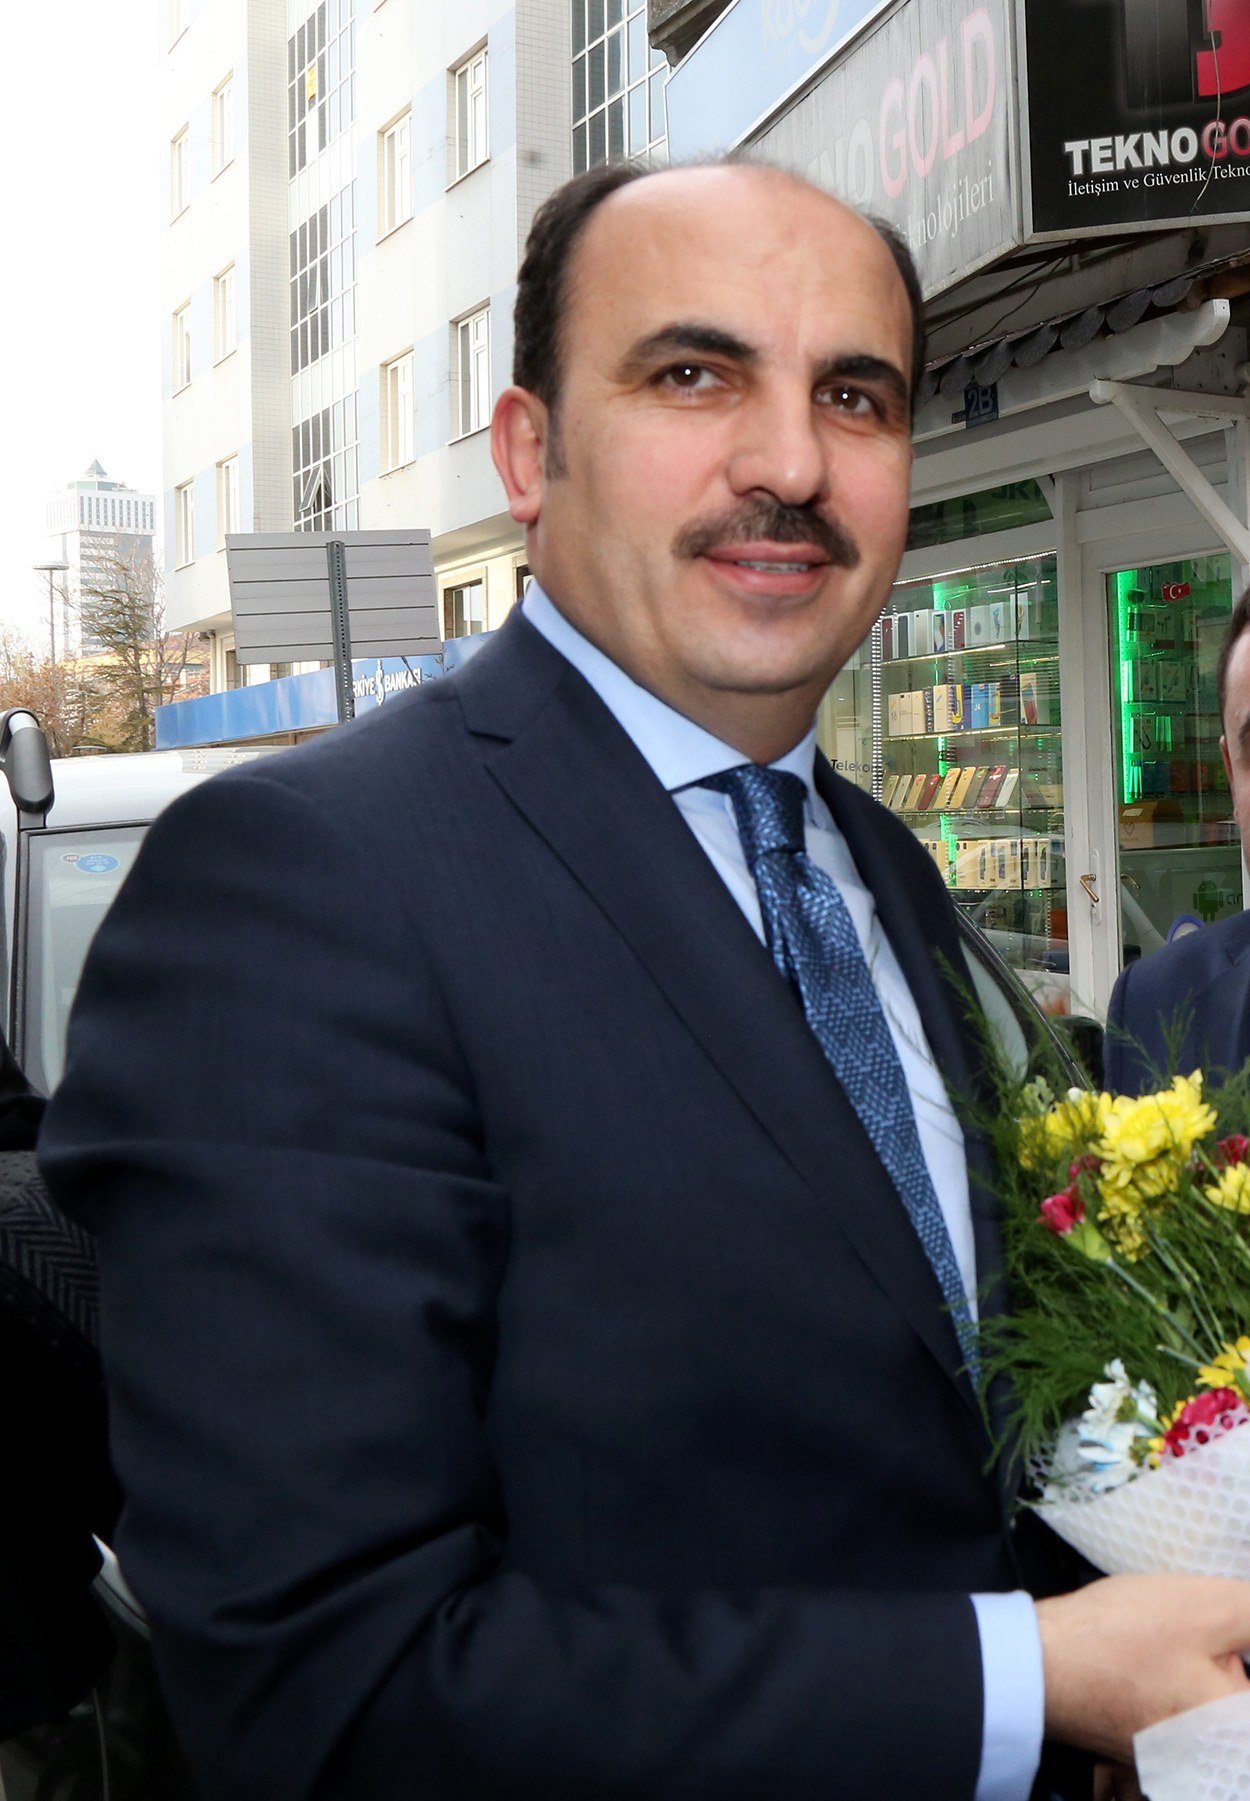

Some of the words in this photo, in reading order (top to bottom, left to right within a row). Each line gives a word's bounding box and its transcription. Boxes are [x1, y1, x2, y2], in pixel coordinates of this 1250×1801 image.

[1068, 178, 1119, 197] İletişim
[1123, 177, 1139, 190] ve
[1143, 168, 1207, 188] Güvenlik
[967, 387, 994, 418] 2B
